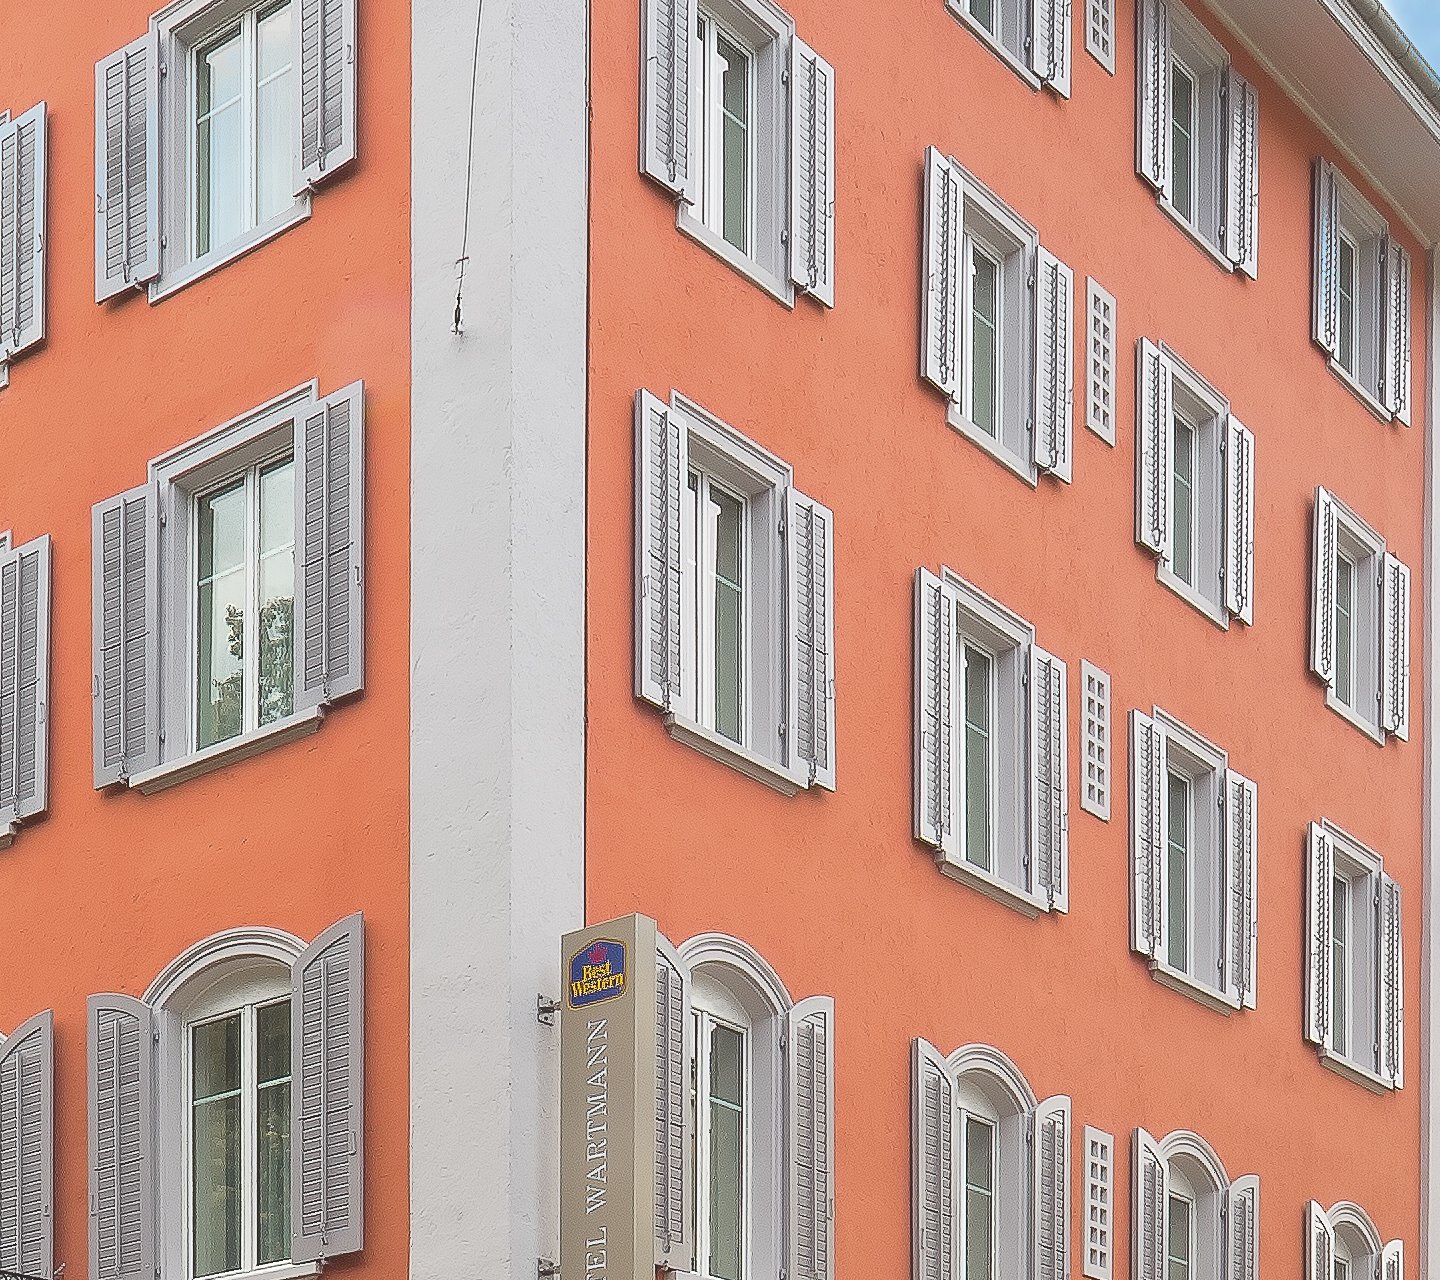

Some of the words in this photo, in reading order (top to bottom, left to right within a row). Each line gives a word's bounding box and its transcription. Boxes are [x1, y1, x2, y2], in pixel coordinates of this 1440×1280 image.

[583, 960, 611, 980] Best
[572, 973, 624, 997] Western
[585, 1019, 608, 1214] WARTMANN
